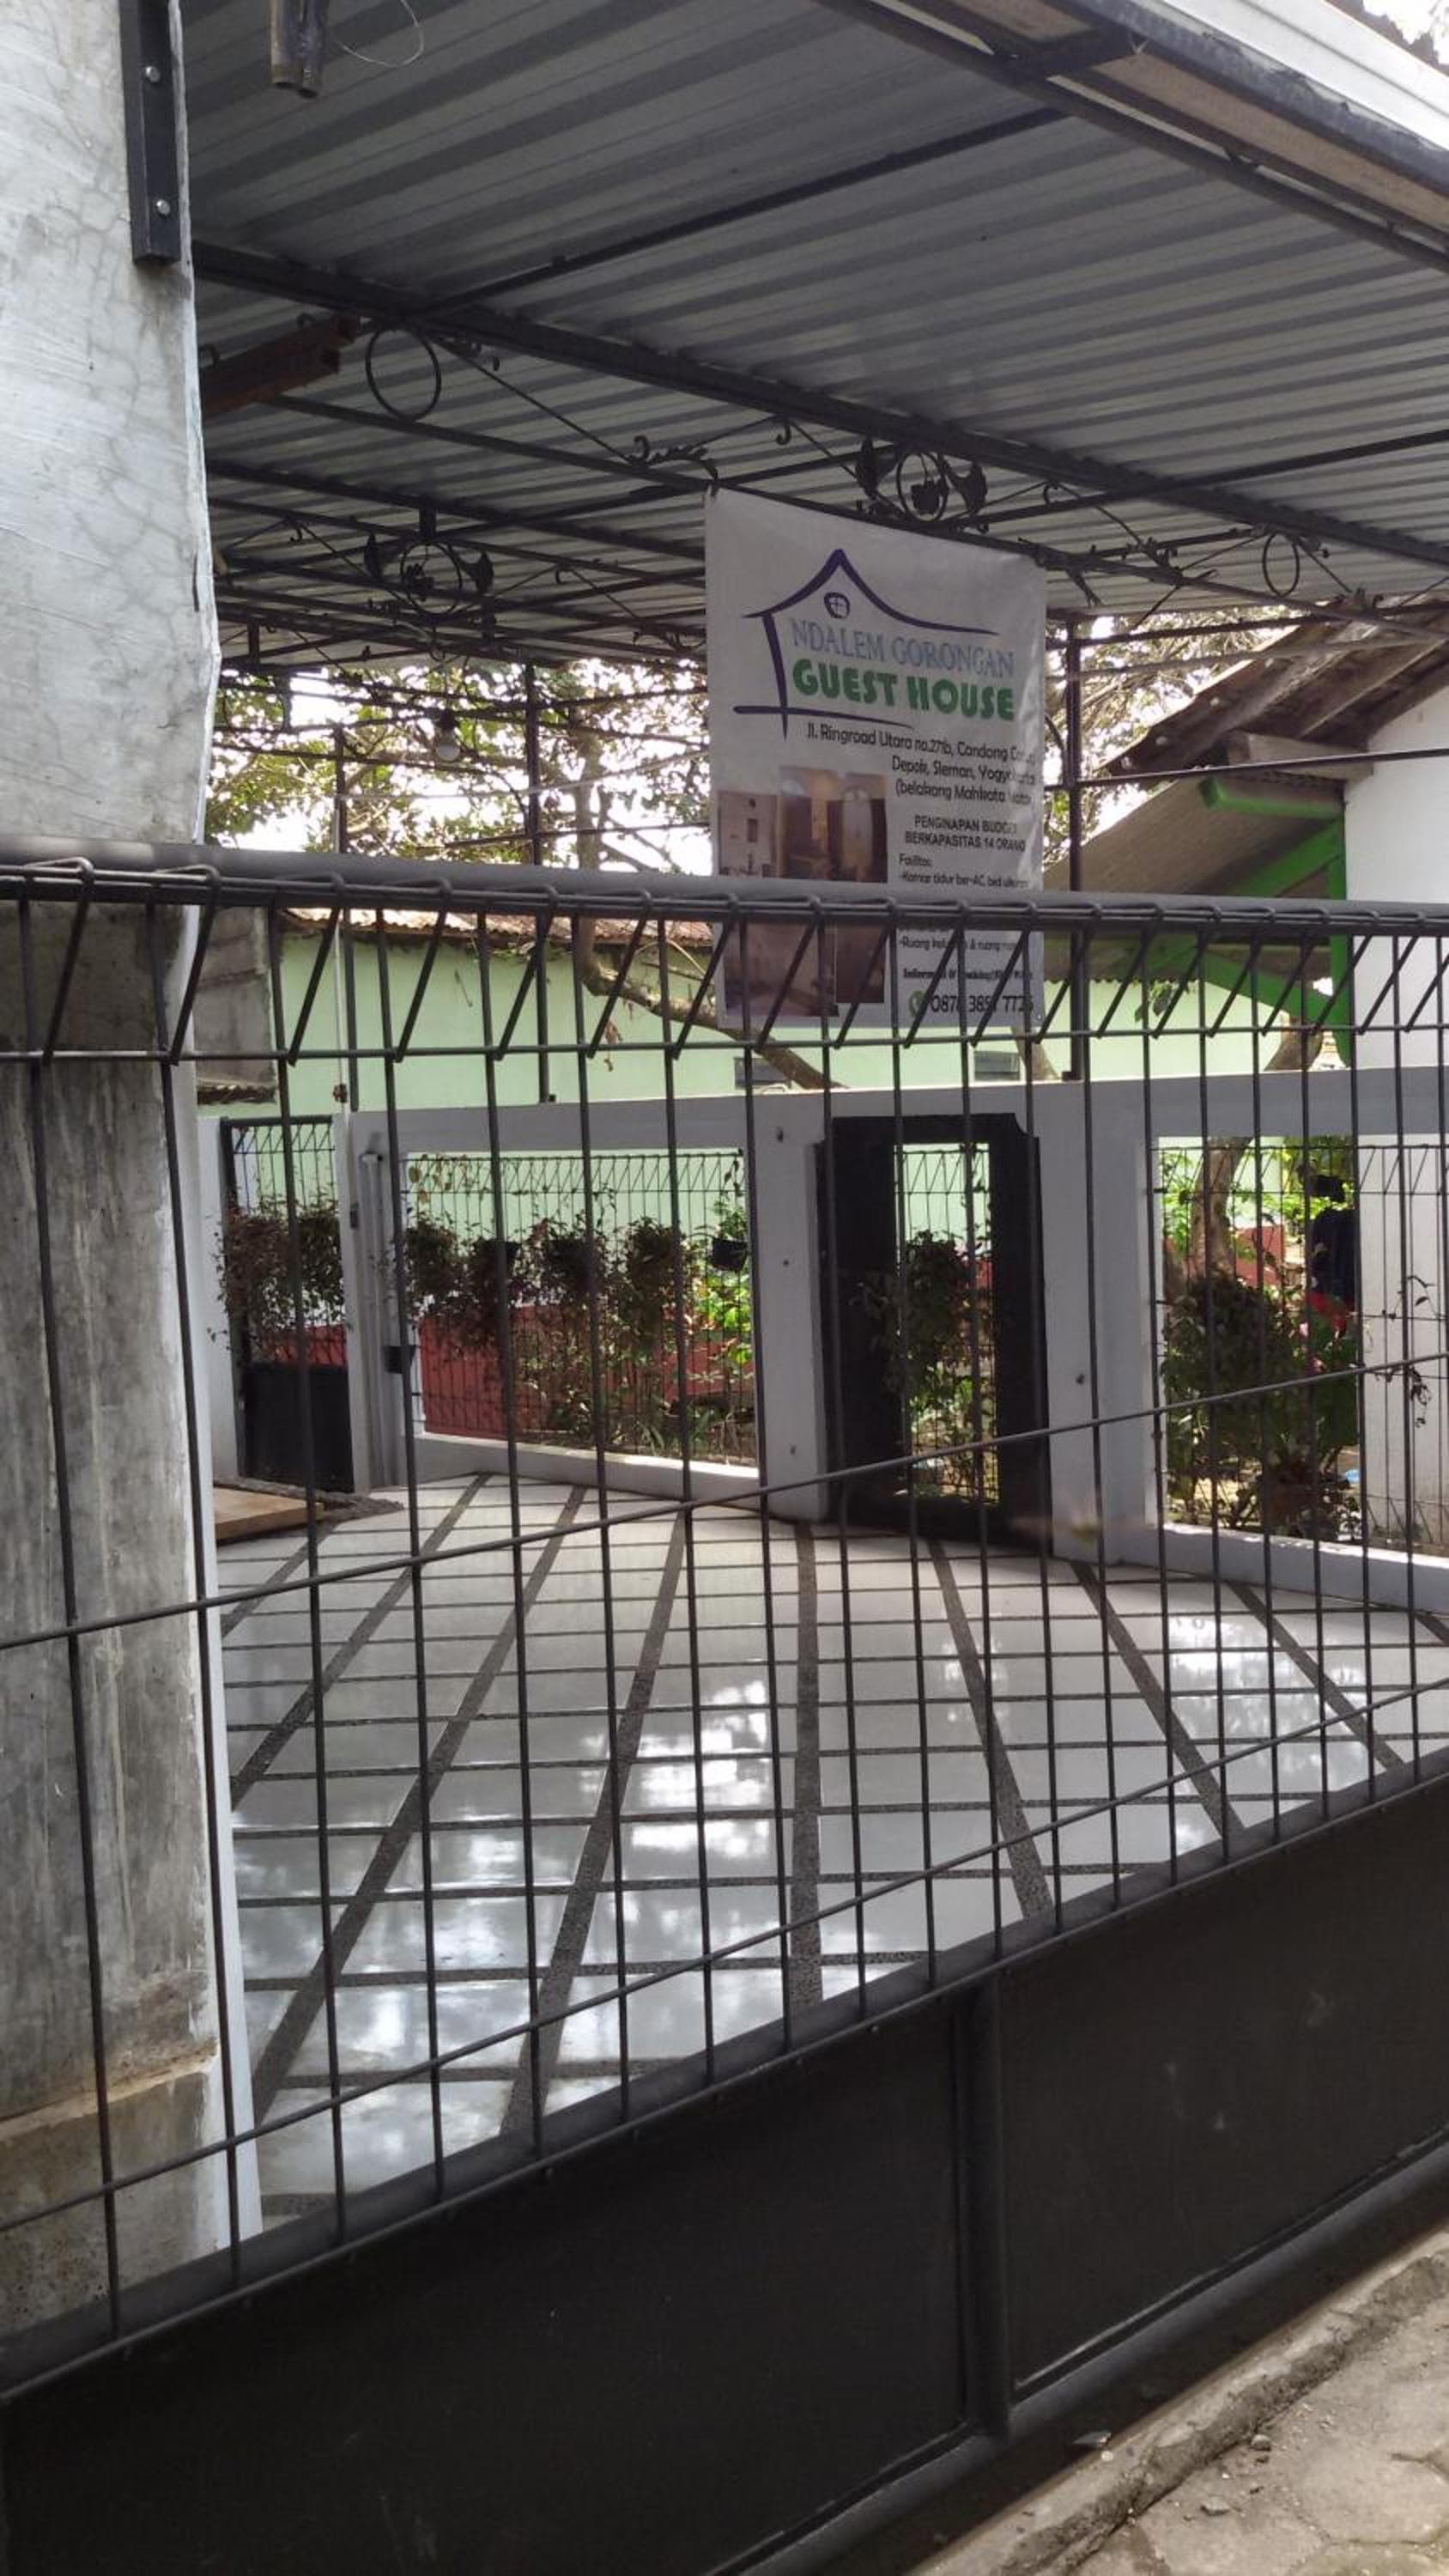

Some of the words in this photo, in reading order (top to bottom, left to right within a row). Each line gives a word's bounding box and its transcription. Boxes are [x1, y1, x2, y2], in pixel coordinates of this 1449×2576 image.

[791, 619, 884, 662] NDALEM
[891, 636, 1014, 677] GORONGAN
[792, 659, 898, 706] GUEST
[906, 675, 1014, 721] HOUSE
[820, 724, 877, 745] Ringroad
[879, 732, 912, 750] Utara
[914, 815, 979, 831] PENGINAPAN
[905, 830, 981, 848] BERKAPASITAS
[985, 838, 994, 848] 14
[931, 994, 962, 1012] 087
